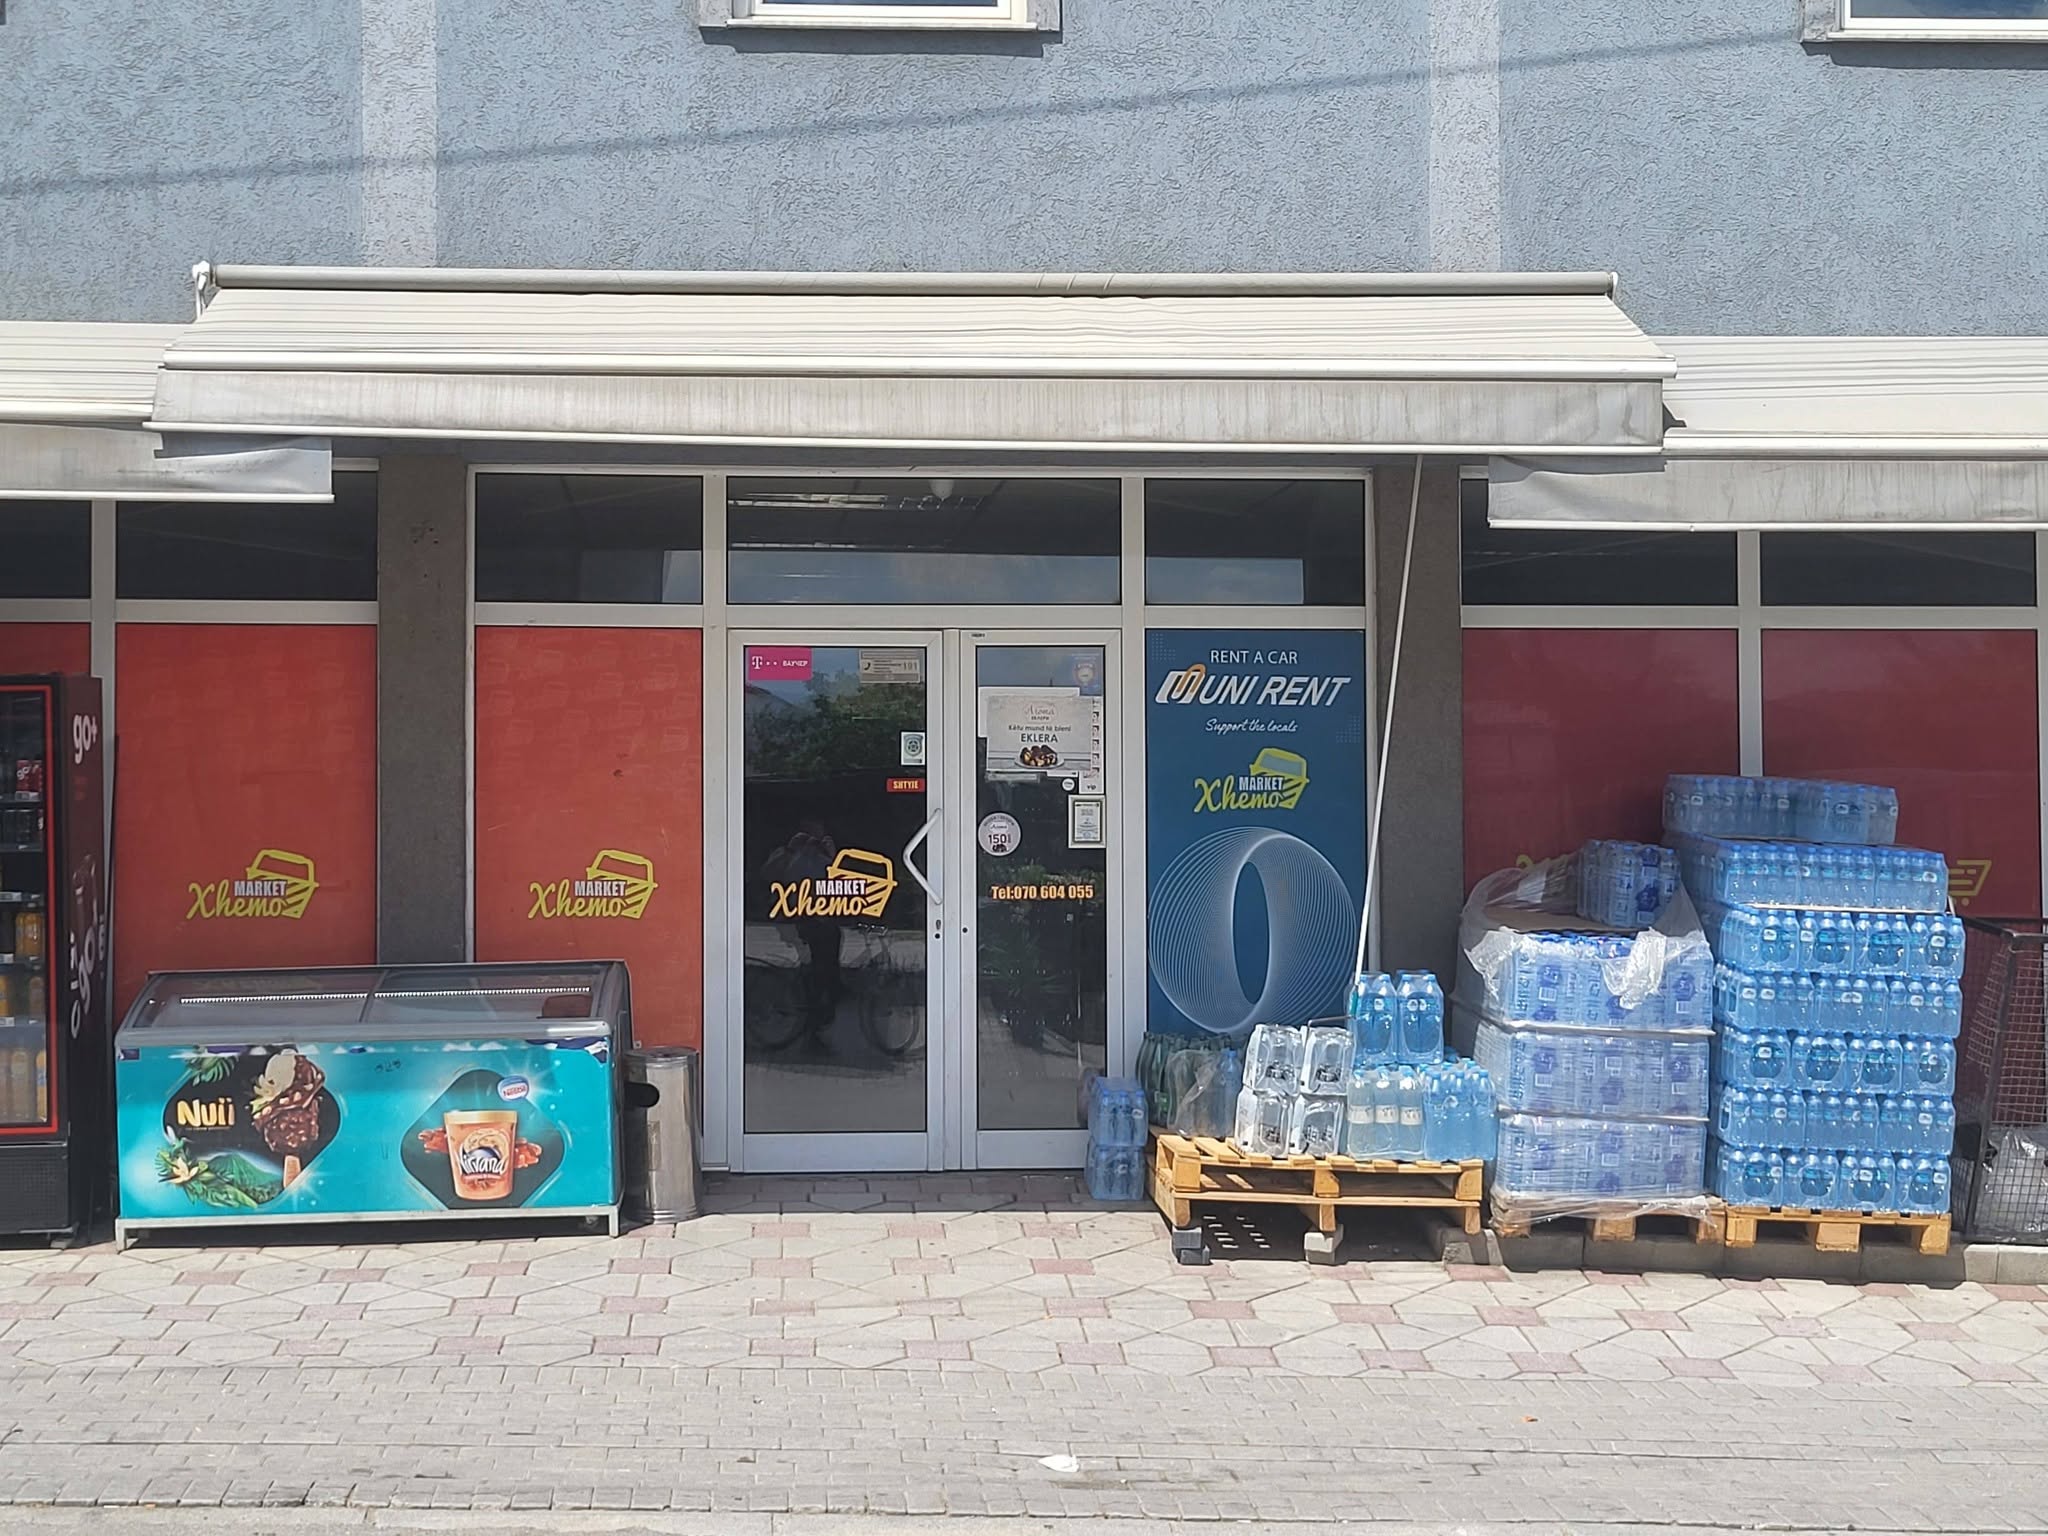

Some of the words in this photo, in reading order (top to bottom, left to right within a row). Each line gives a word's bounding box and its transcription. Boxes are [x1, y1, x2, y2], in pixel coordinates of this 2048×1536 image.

[1210, 650, 1249, 664] RENT
[1253, 650, 1264, 664] A
[1267, 651, 1298, 664] CAR
[1256, 676, 1351, 706] RENT
[1205, 718, 1248, 735] Support
[1248, 718, 1266, 732] the
[1266, 720, 1299, 732] locals
[1020, 733, 1058, 743] EKLERA
[1238, 776, 1284, 791] MARKET
[1193, 774, 1283, 813] Xhemo
[234, 880, 287, 896] MARKET
[574, 880, 627, 896] MARKET
[815, 879, 867, 896] MARKET
[1040, 885, 1065, 899] 604
[1068, 885, 1094, 899] 055
[186, 879, 287, 920] Xhemo
[527, 878, 627, 919] Xhemo
[769, 878, 867, 919] Xhemo
[176, 1097, 236, 1127] Nuii
